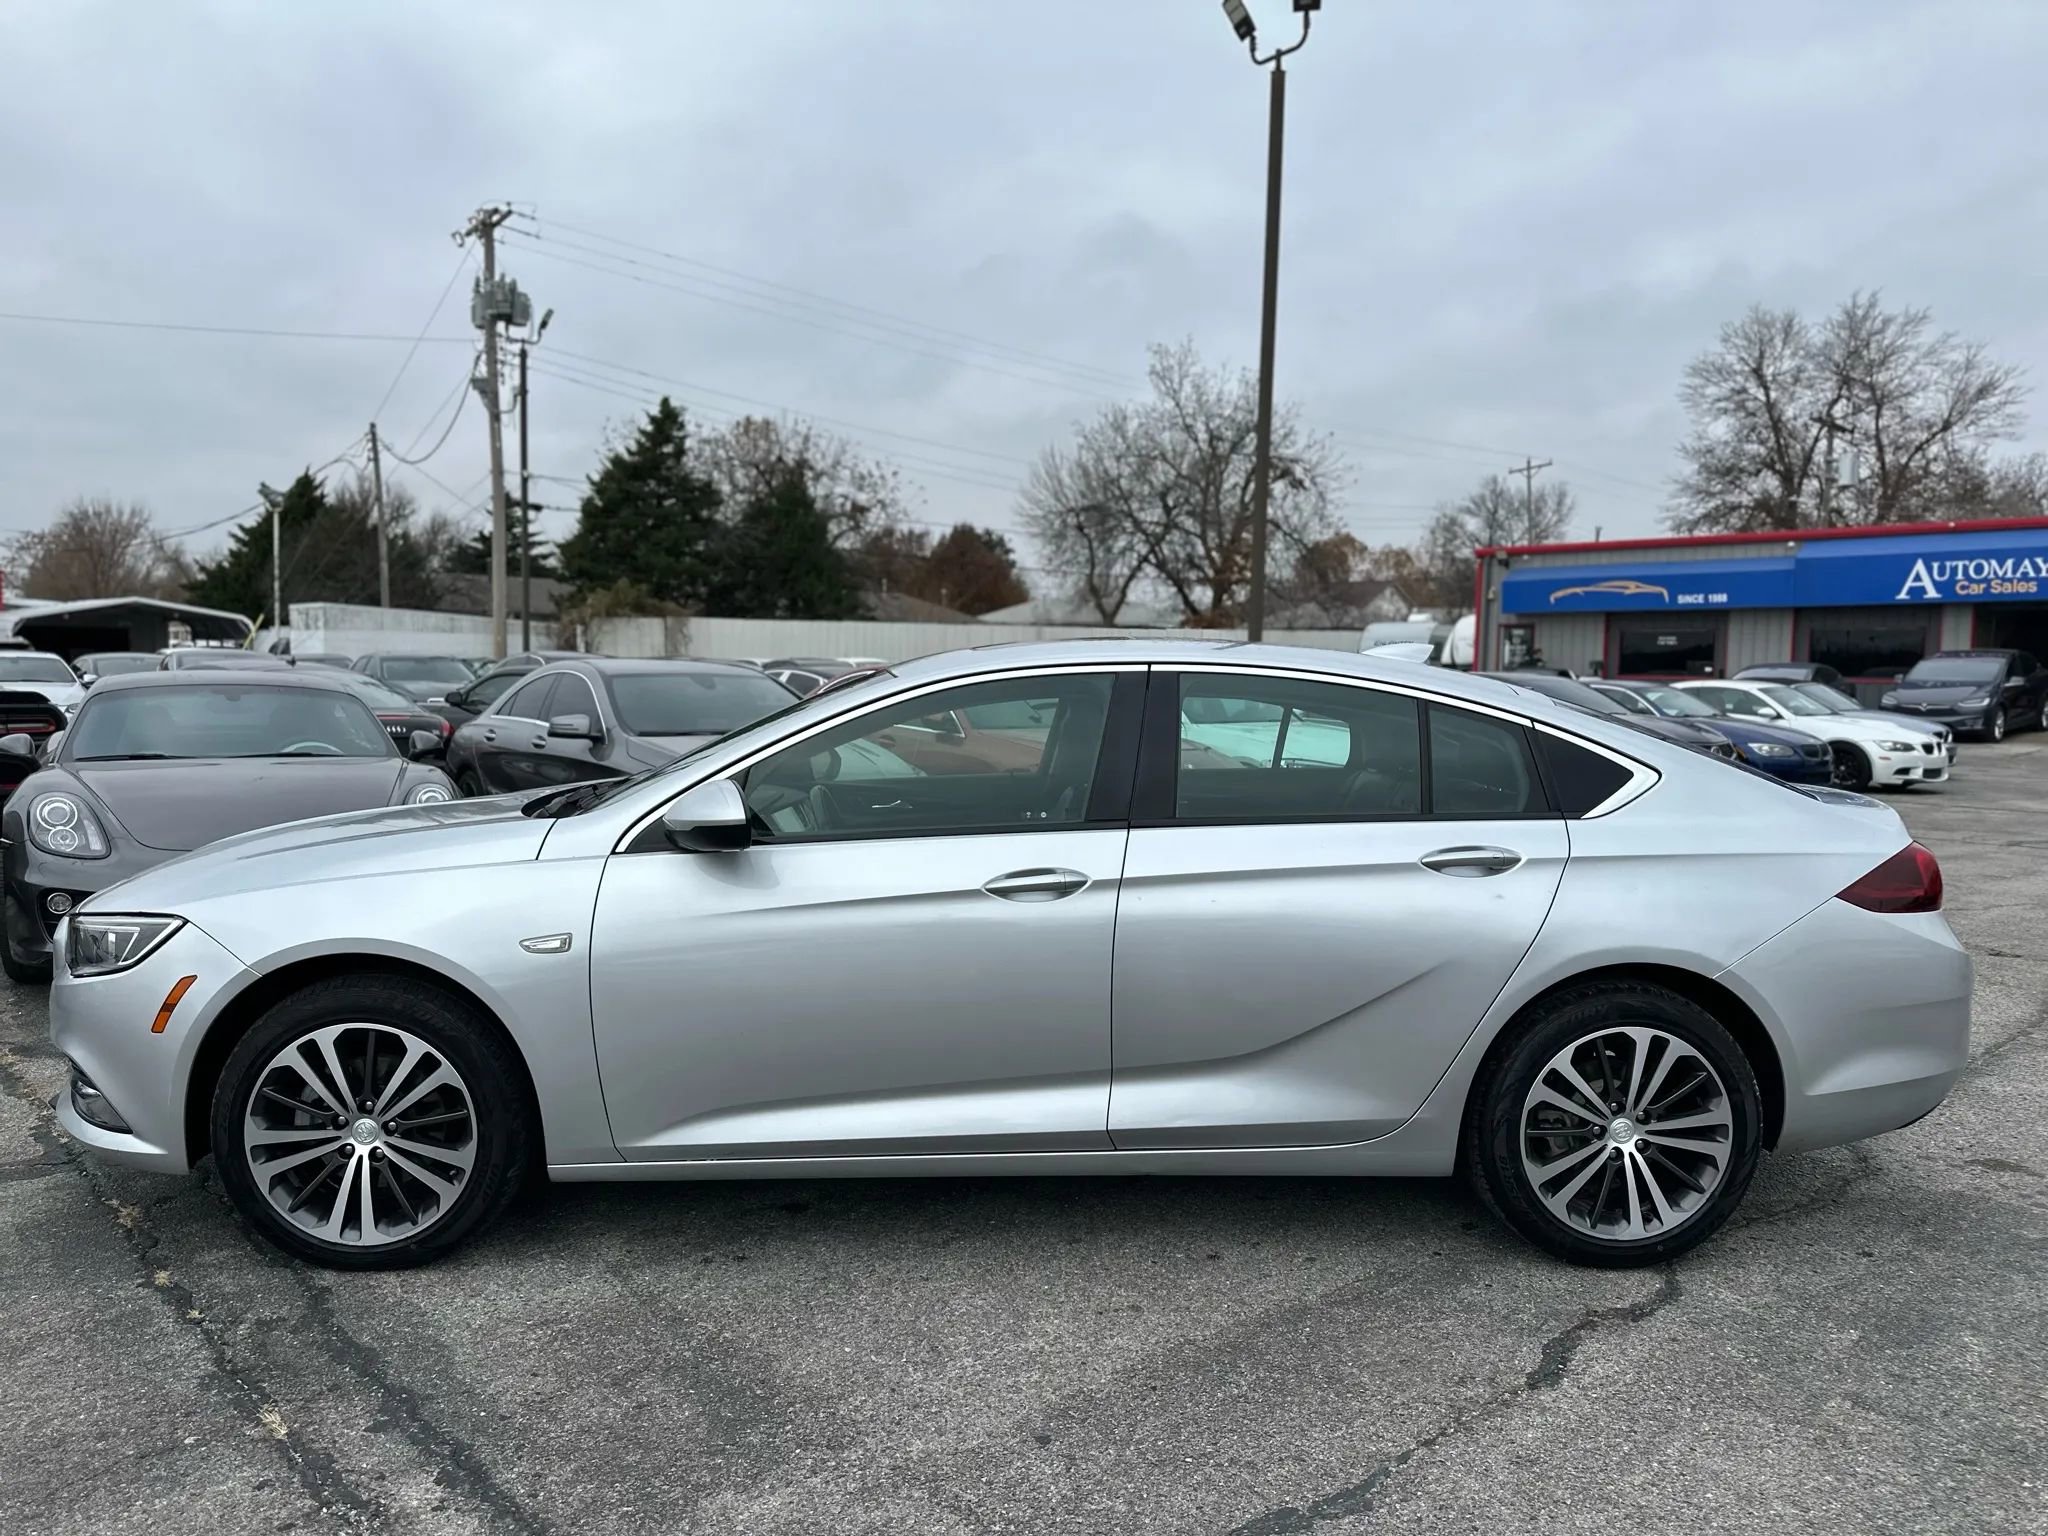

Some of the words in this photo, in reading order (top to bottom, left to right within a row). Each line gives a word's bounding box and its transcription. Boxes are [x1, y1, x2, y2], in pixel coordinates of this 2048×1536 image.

[1955, 580, 1986, 595] Car
[1990, 579, 2038, 594] Sales
[1677, 593, 1705, 605] SINCE
